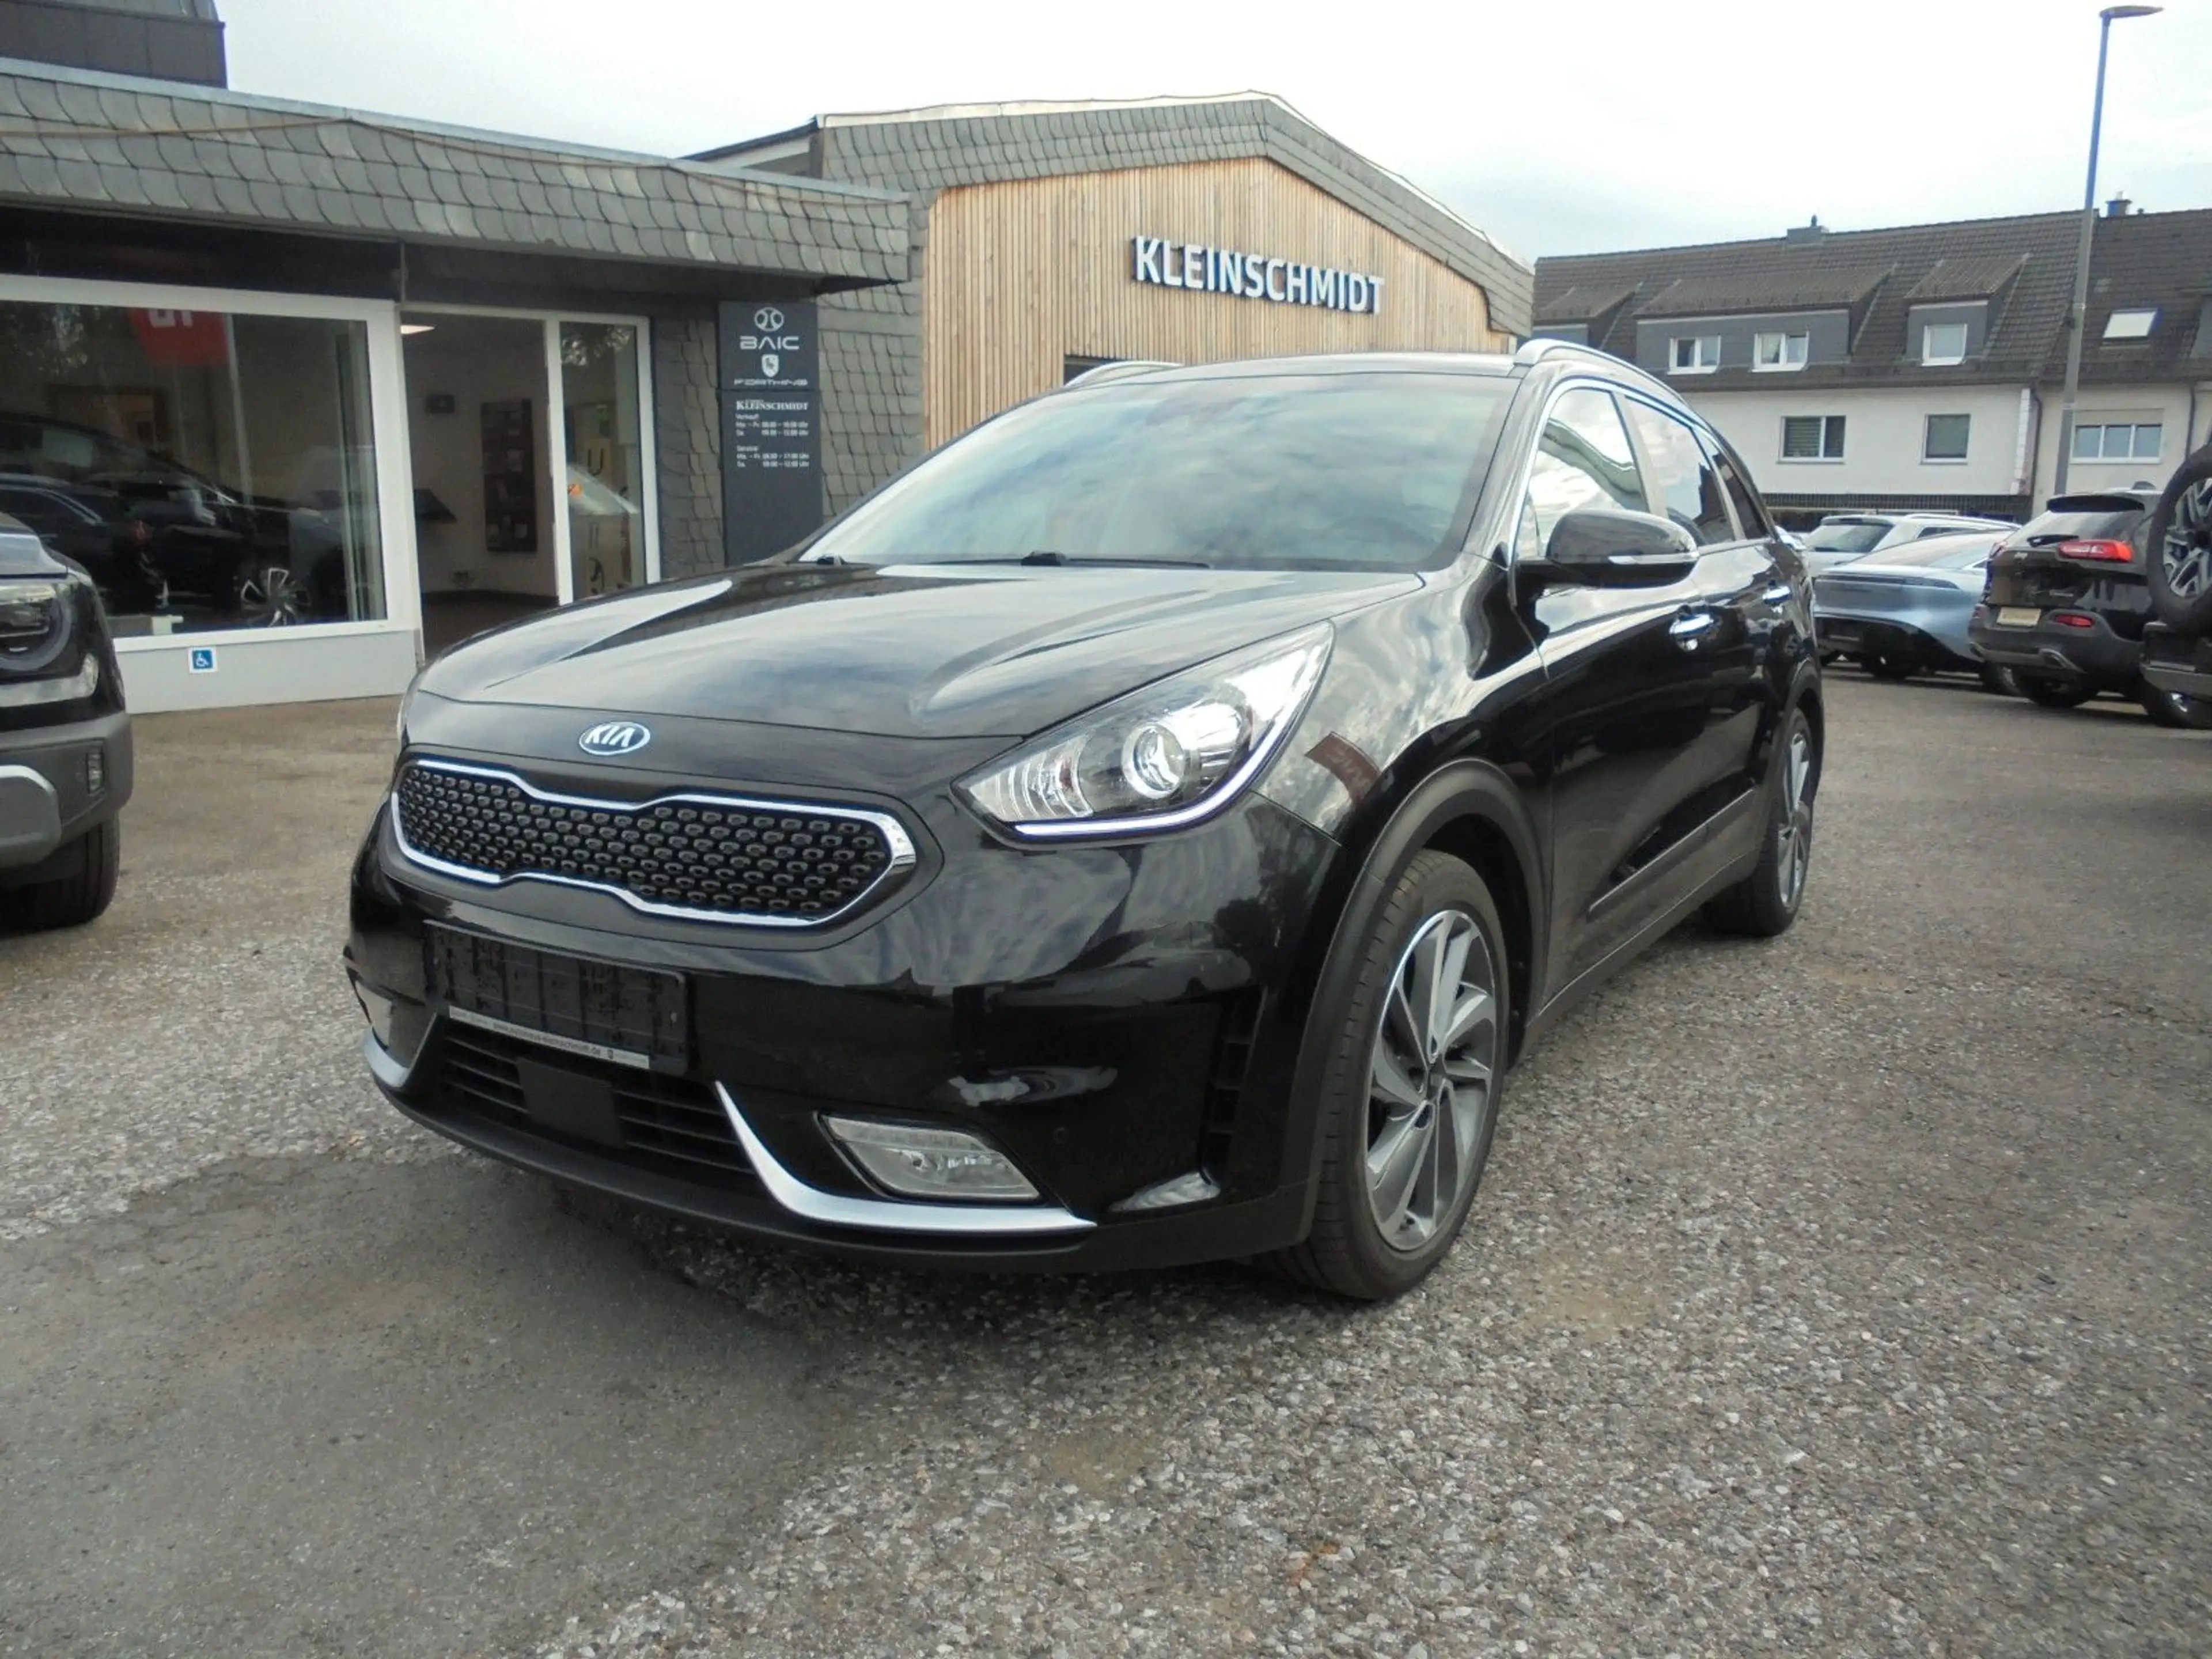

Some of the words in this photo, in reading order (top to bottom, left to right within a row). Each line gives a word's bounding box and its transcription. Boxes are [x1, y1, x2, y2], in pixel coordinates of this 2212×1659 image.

[1134, 235, 1385, 315] KLEINSCHMIDT
[740, 336, 800, 350] BAIC
[585, 725, 635, 748] KIA
